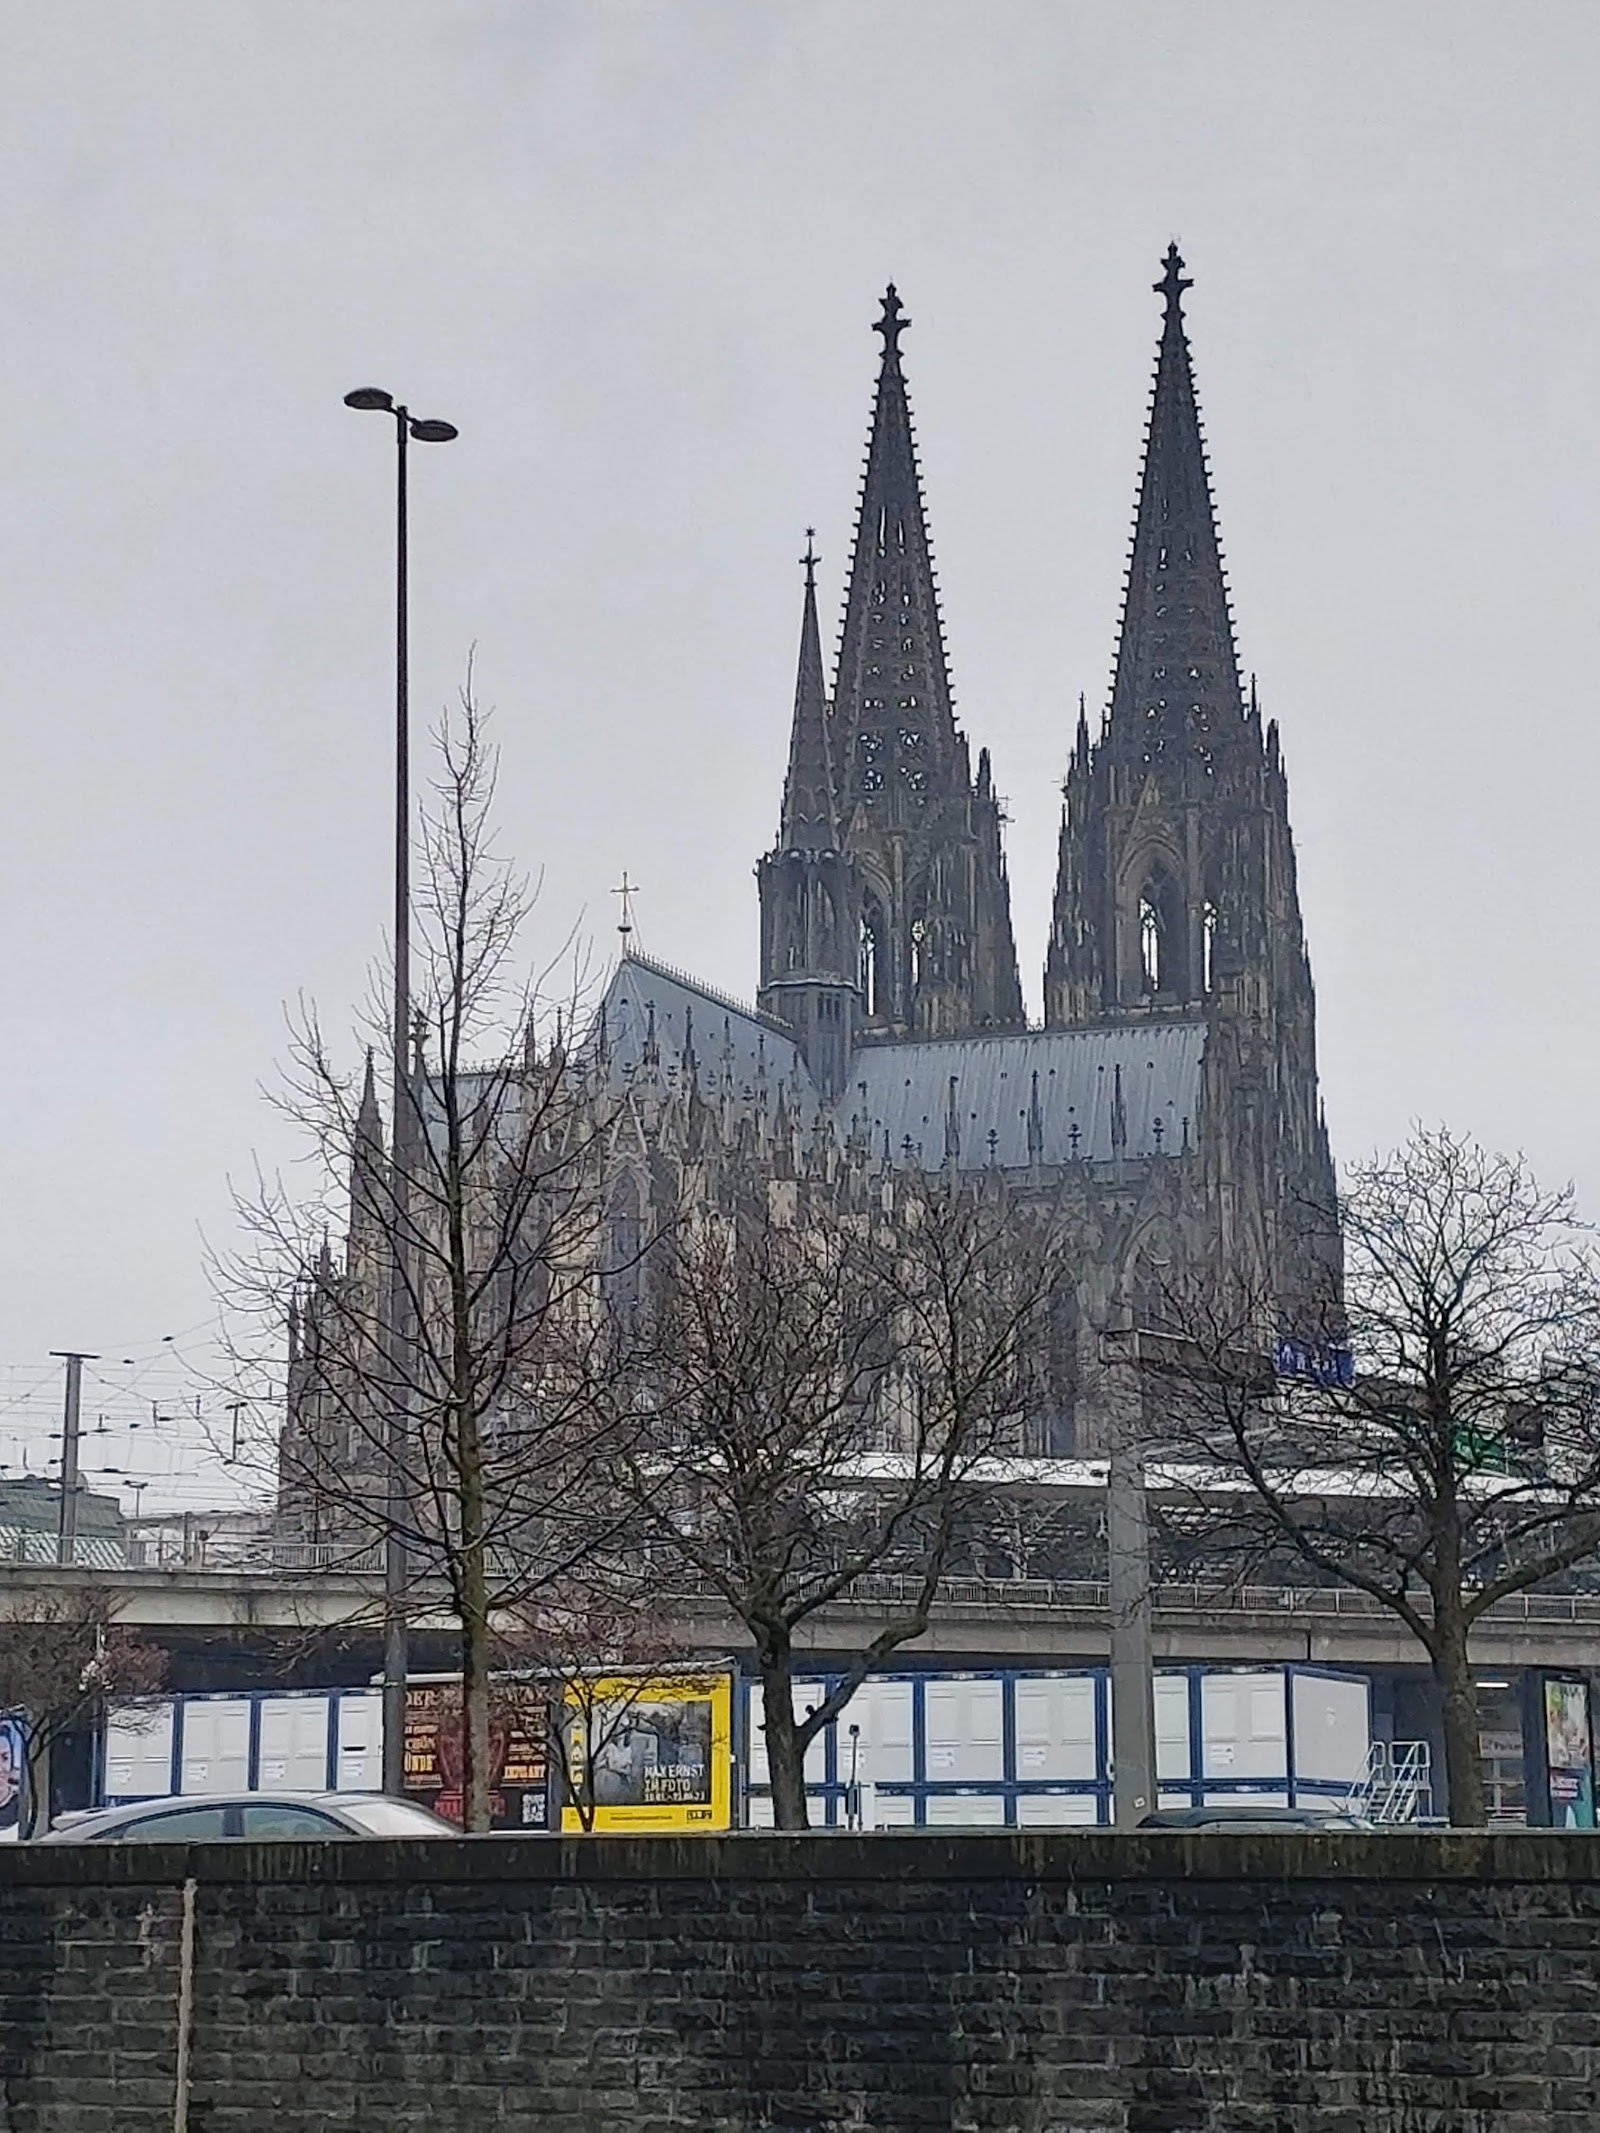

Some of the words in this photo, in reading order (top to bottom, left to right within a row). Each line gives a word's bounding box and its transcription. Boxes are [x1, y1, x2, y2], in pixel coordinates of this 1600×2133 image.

[644, 1764, 666, 1778] MAX
[668, 1763, 705, 1778] ERNST
[644, 1779, 659, 1792] IM
[661, 1778, 691, 1792] FOTO
